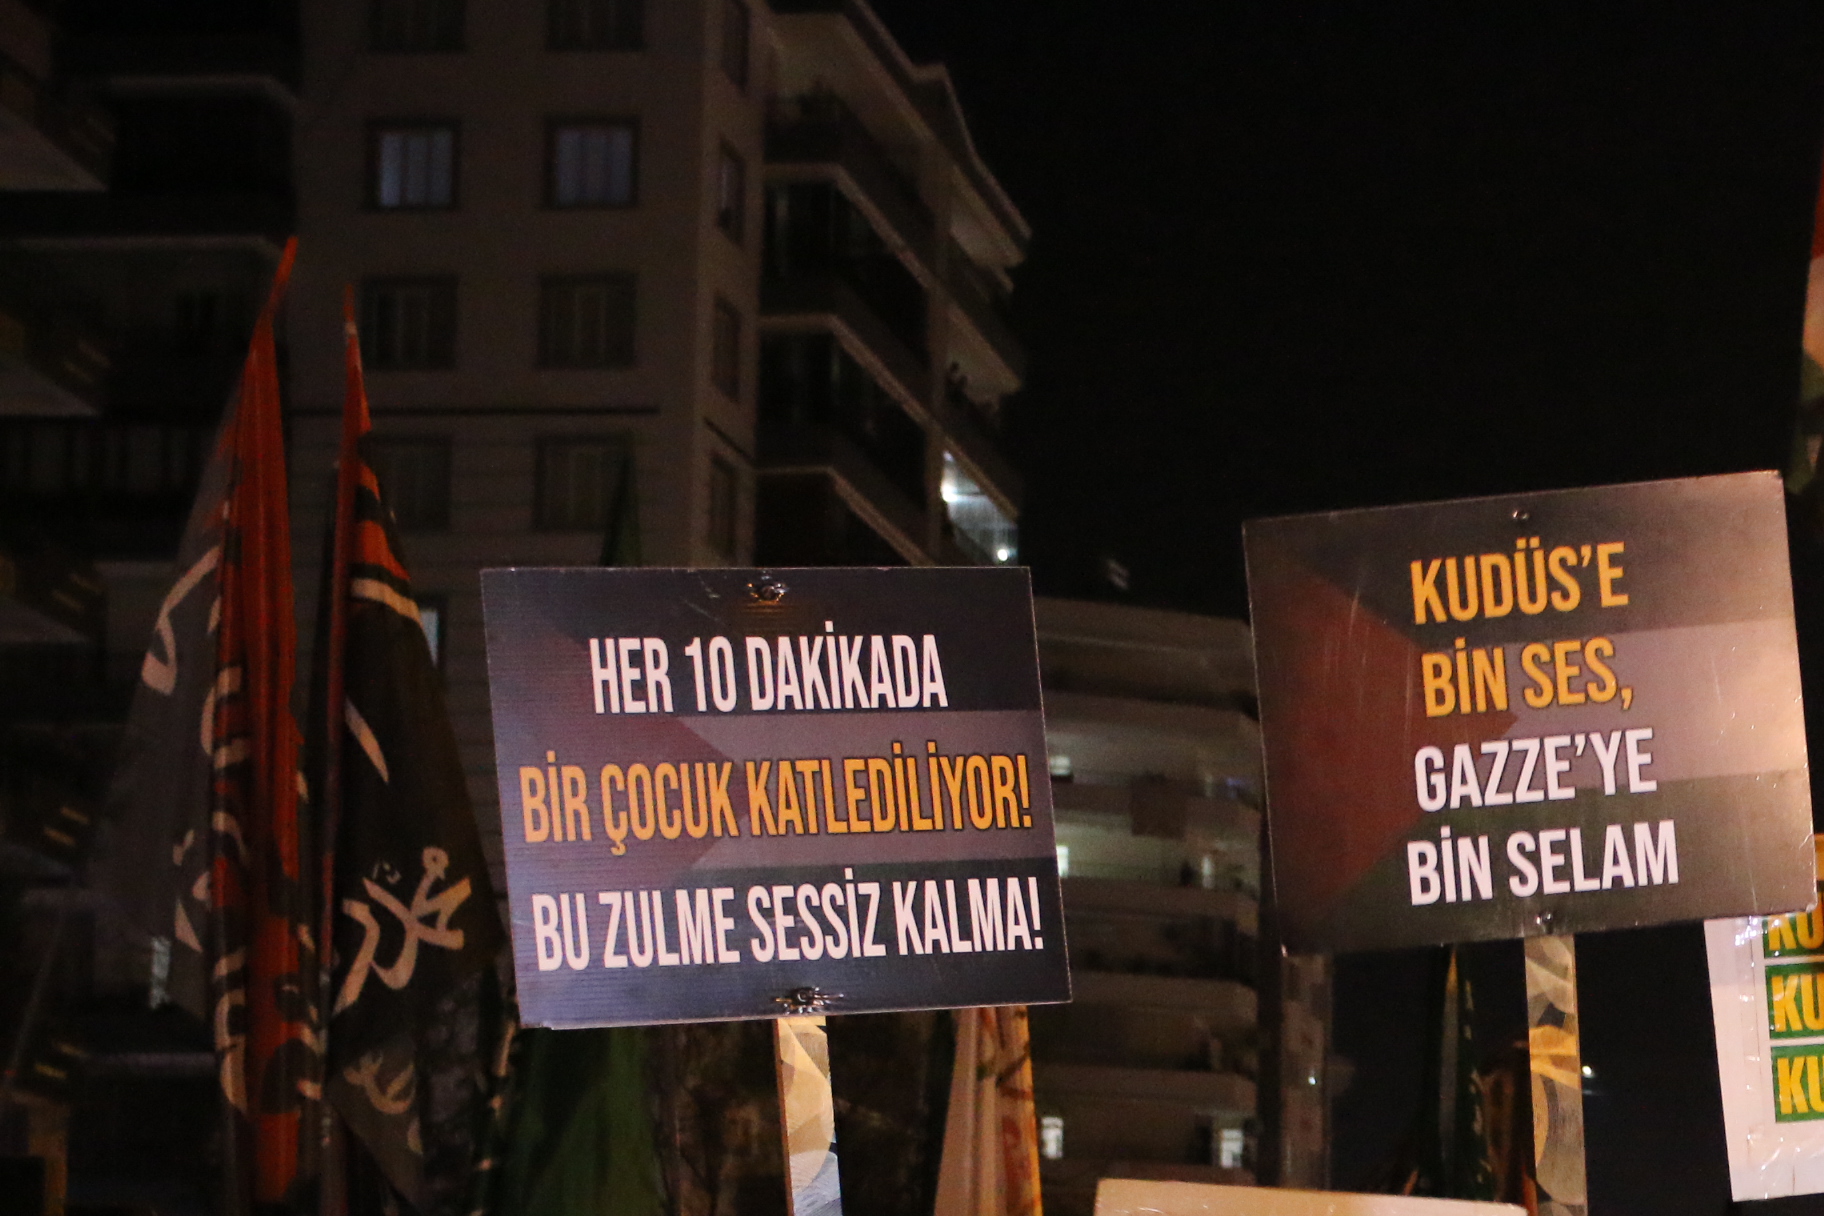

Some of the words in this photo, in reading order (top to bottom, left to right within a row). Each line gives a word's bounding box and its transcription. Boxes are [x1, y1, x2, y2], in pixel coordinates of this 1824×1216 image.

[1410, 536, 1629, 625] KUDÜS'E
[590, 637, 673, 714] HER
[685, 636, 737, 713] 10
[746, 620, 949, 711] DAKİKADA
[1422, 637, 1508, 718] BİN
[1521, 637, 1634, 710] SES,
[519, 750, 592, 843] BİR
[603, 761, 739, 856] ÇOCUK
[746, 741, 1032, 835] KATLEDİLİYOR!
[1414, 728, 1658, 813] GAZZE'YE
[1406, 825, 1494, 906] BİN
[1506, 819, 1680, 898] SELAM
[532, 892, 591, 972] BU
[599, 887, 741, 969] ZULME
[747, 867, 887, 962] SESSİZ
[892, 876, 1045, 956] KALMA!
